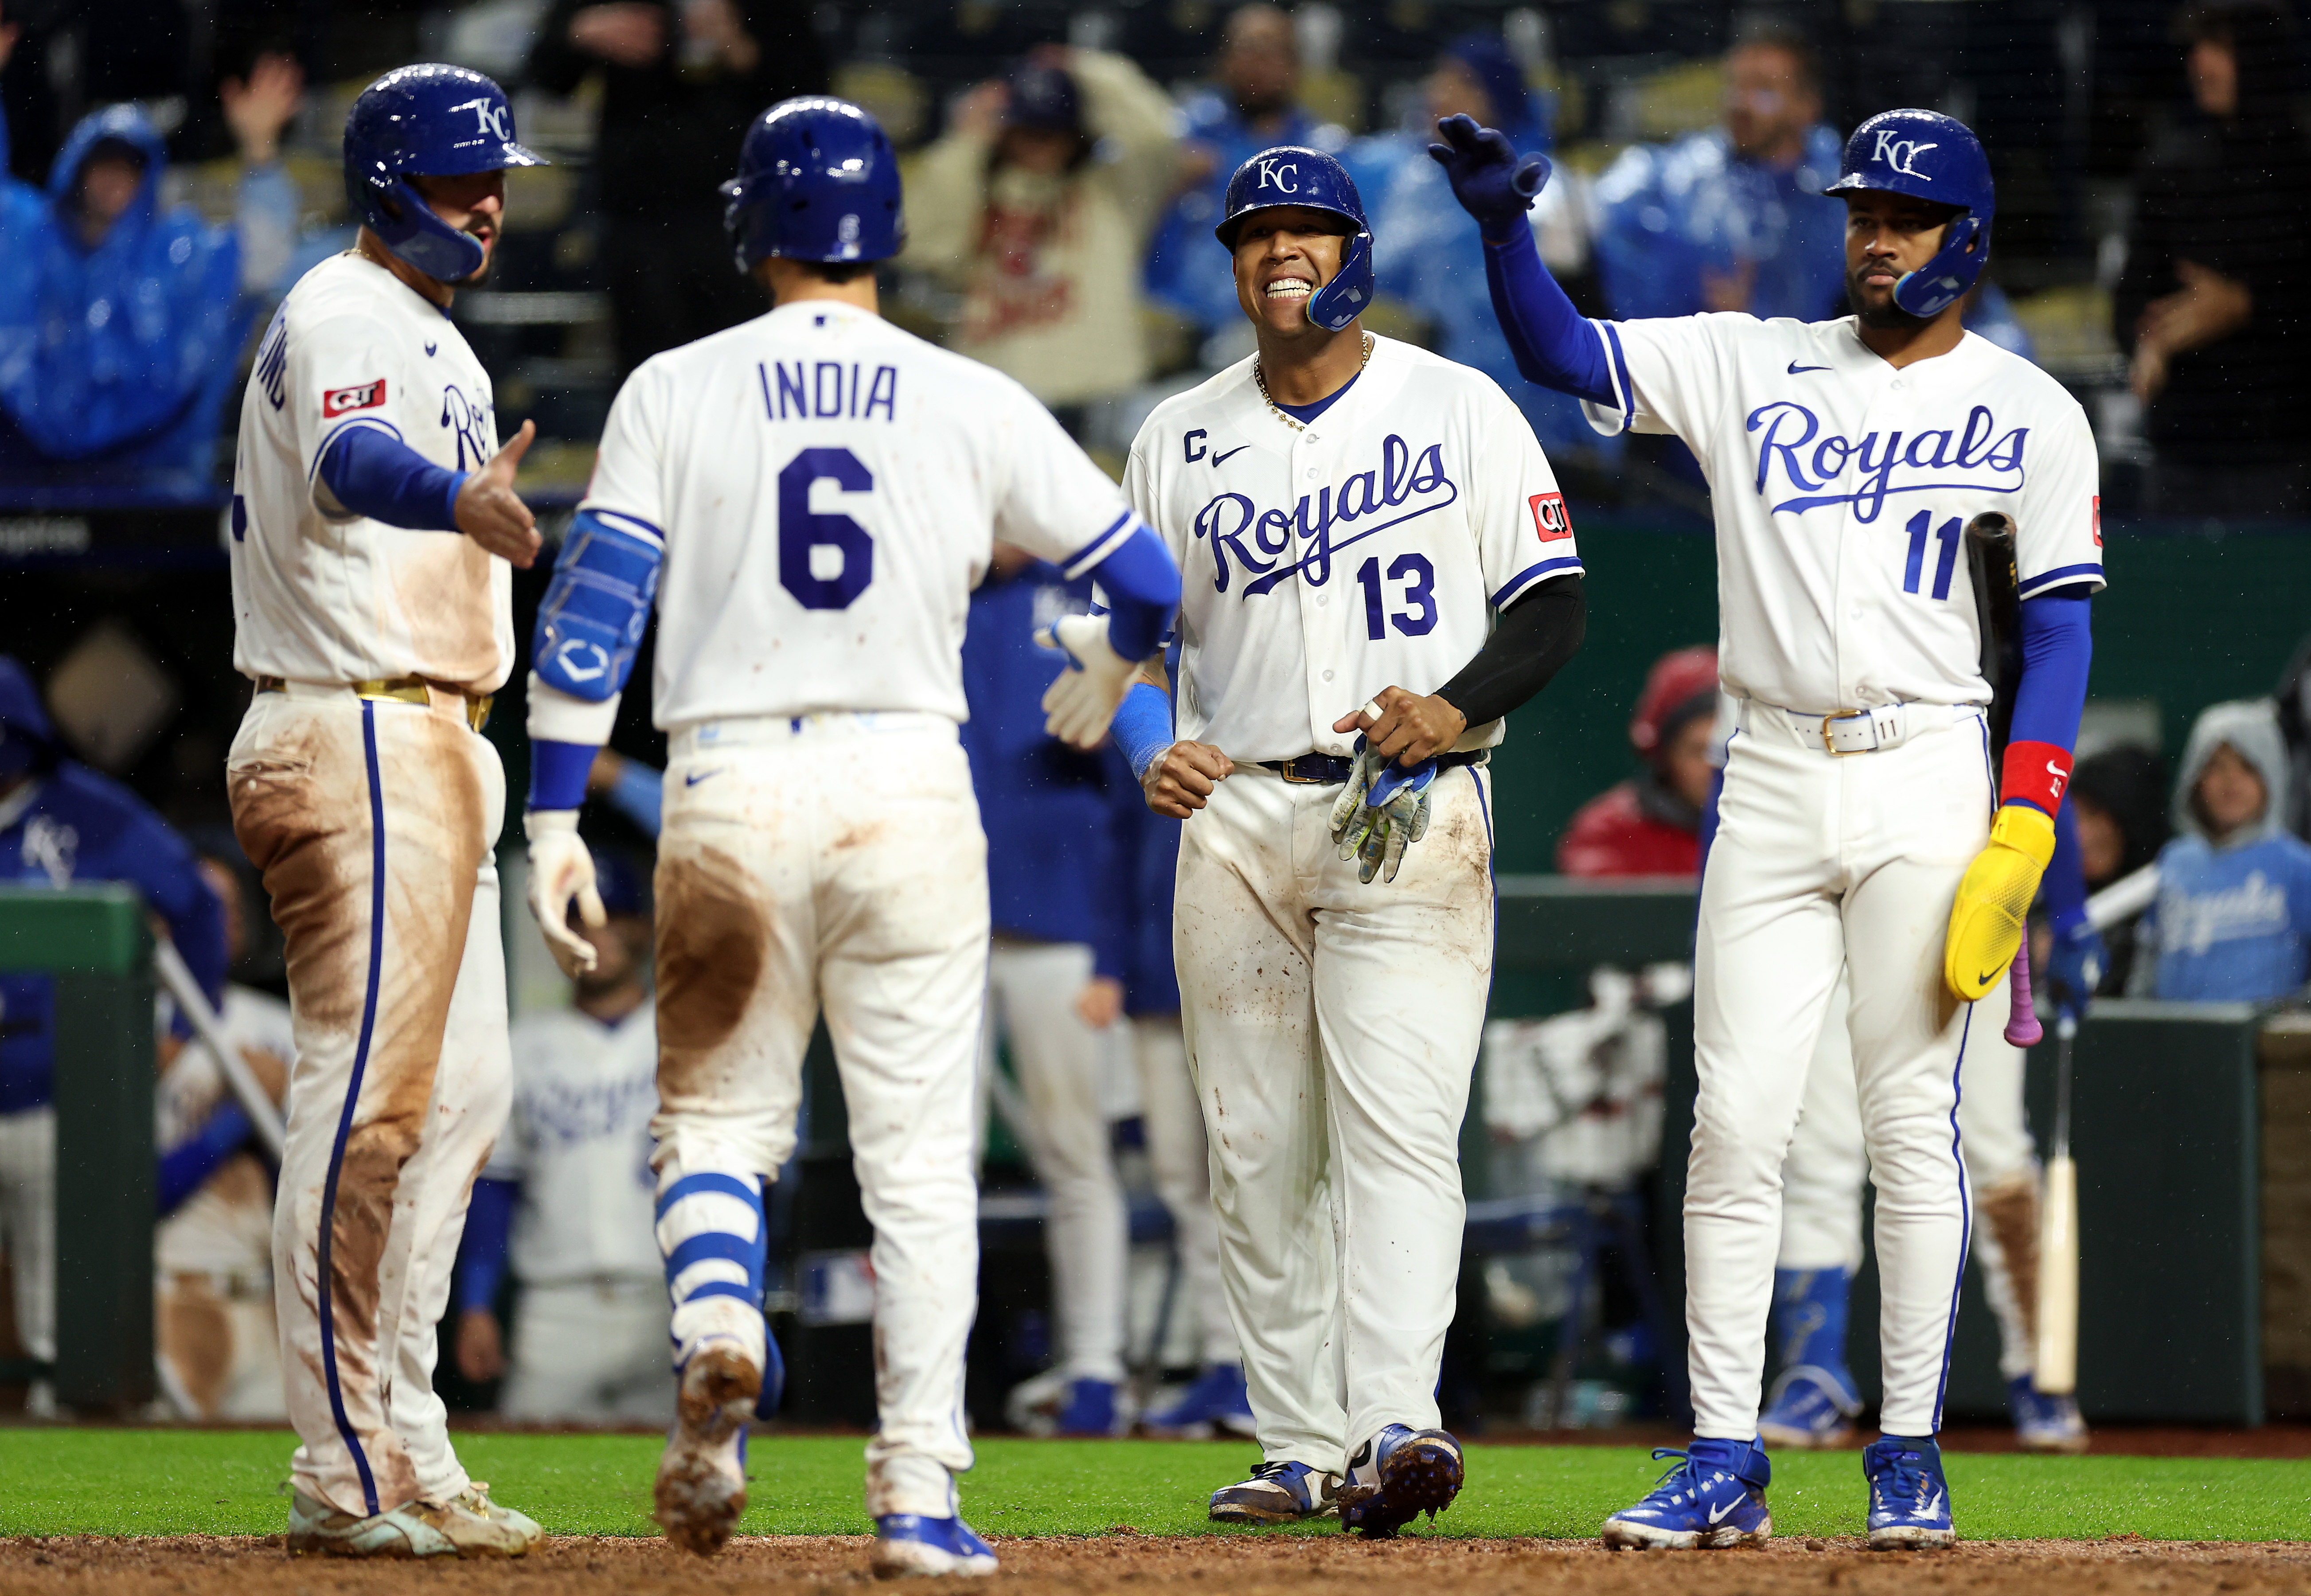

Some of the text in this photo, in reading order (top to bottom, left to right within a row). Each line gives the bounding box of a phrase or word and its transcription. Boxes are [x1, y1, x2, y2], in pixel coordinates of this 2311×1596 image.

[472, 97, 511, 142] KC
[1257, 158, 1298, 193] KC
[1870, 130, 1916, 173] KC
[759, 361, 896, 421] INDIA
[1184, 428, 1207, 464] C
[1746, 401, 2031, 524] Royals
[779, 448, 873, 610] 6
[1194, 433, 1458, 603] Royals
[1537, 498, 1568, 535] QT
[1903, 509, 1963, 601] 11
[1357, 553, 1438, 640] 13
[1880, 720, 1896, 740] 11
